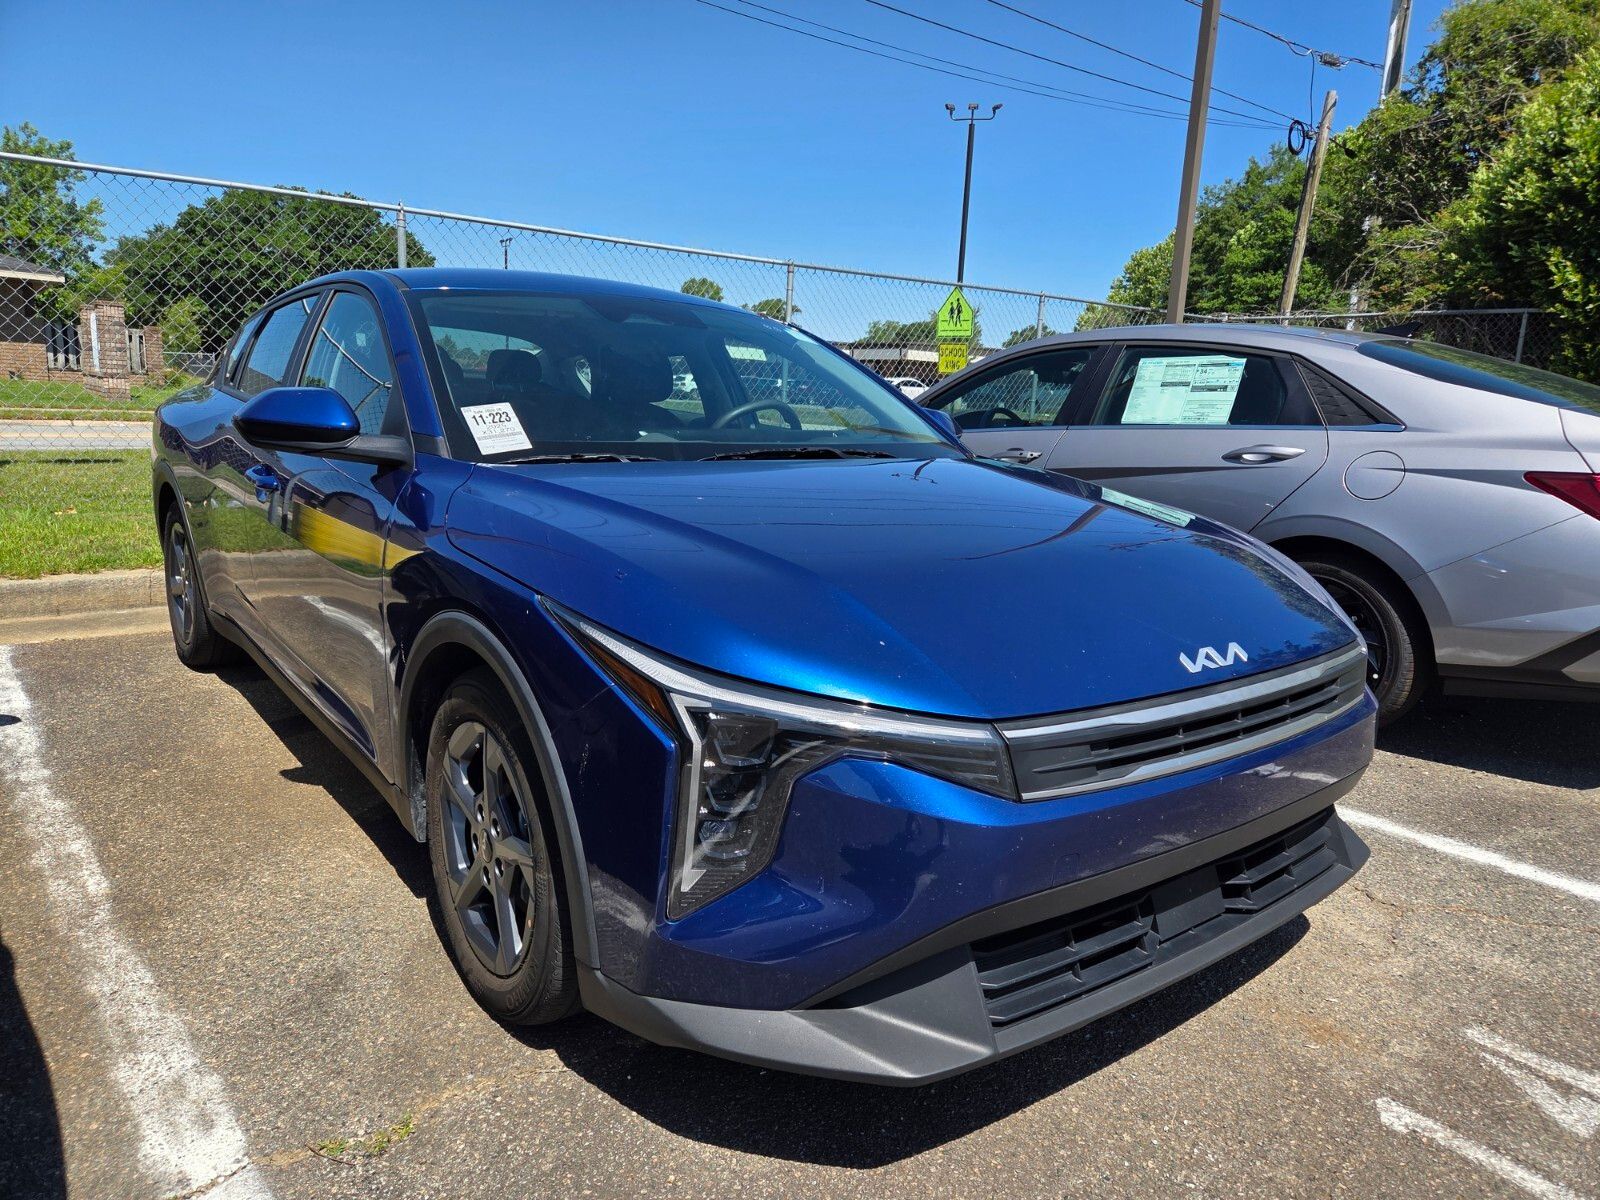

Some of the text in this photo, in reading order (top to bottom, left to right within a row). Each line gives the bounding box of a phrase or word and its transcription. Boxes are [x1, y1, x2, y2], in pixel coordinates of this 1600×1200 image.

[940, 347, 965, 357] SCHOOL
[945, 360, 961, 370] XING
[471, 411, 512, 426] 11:223
[1179, 641, 1248, 674] KIA
